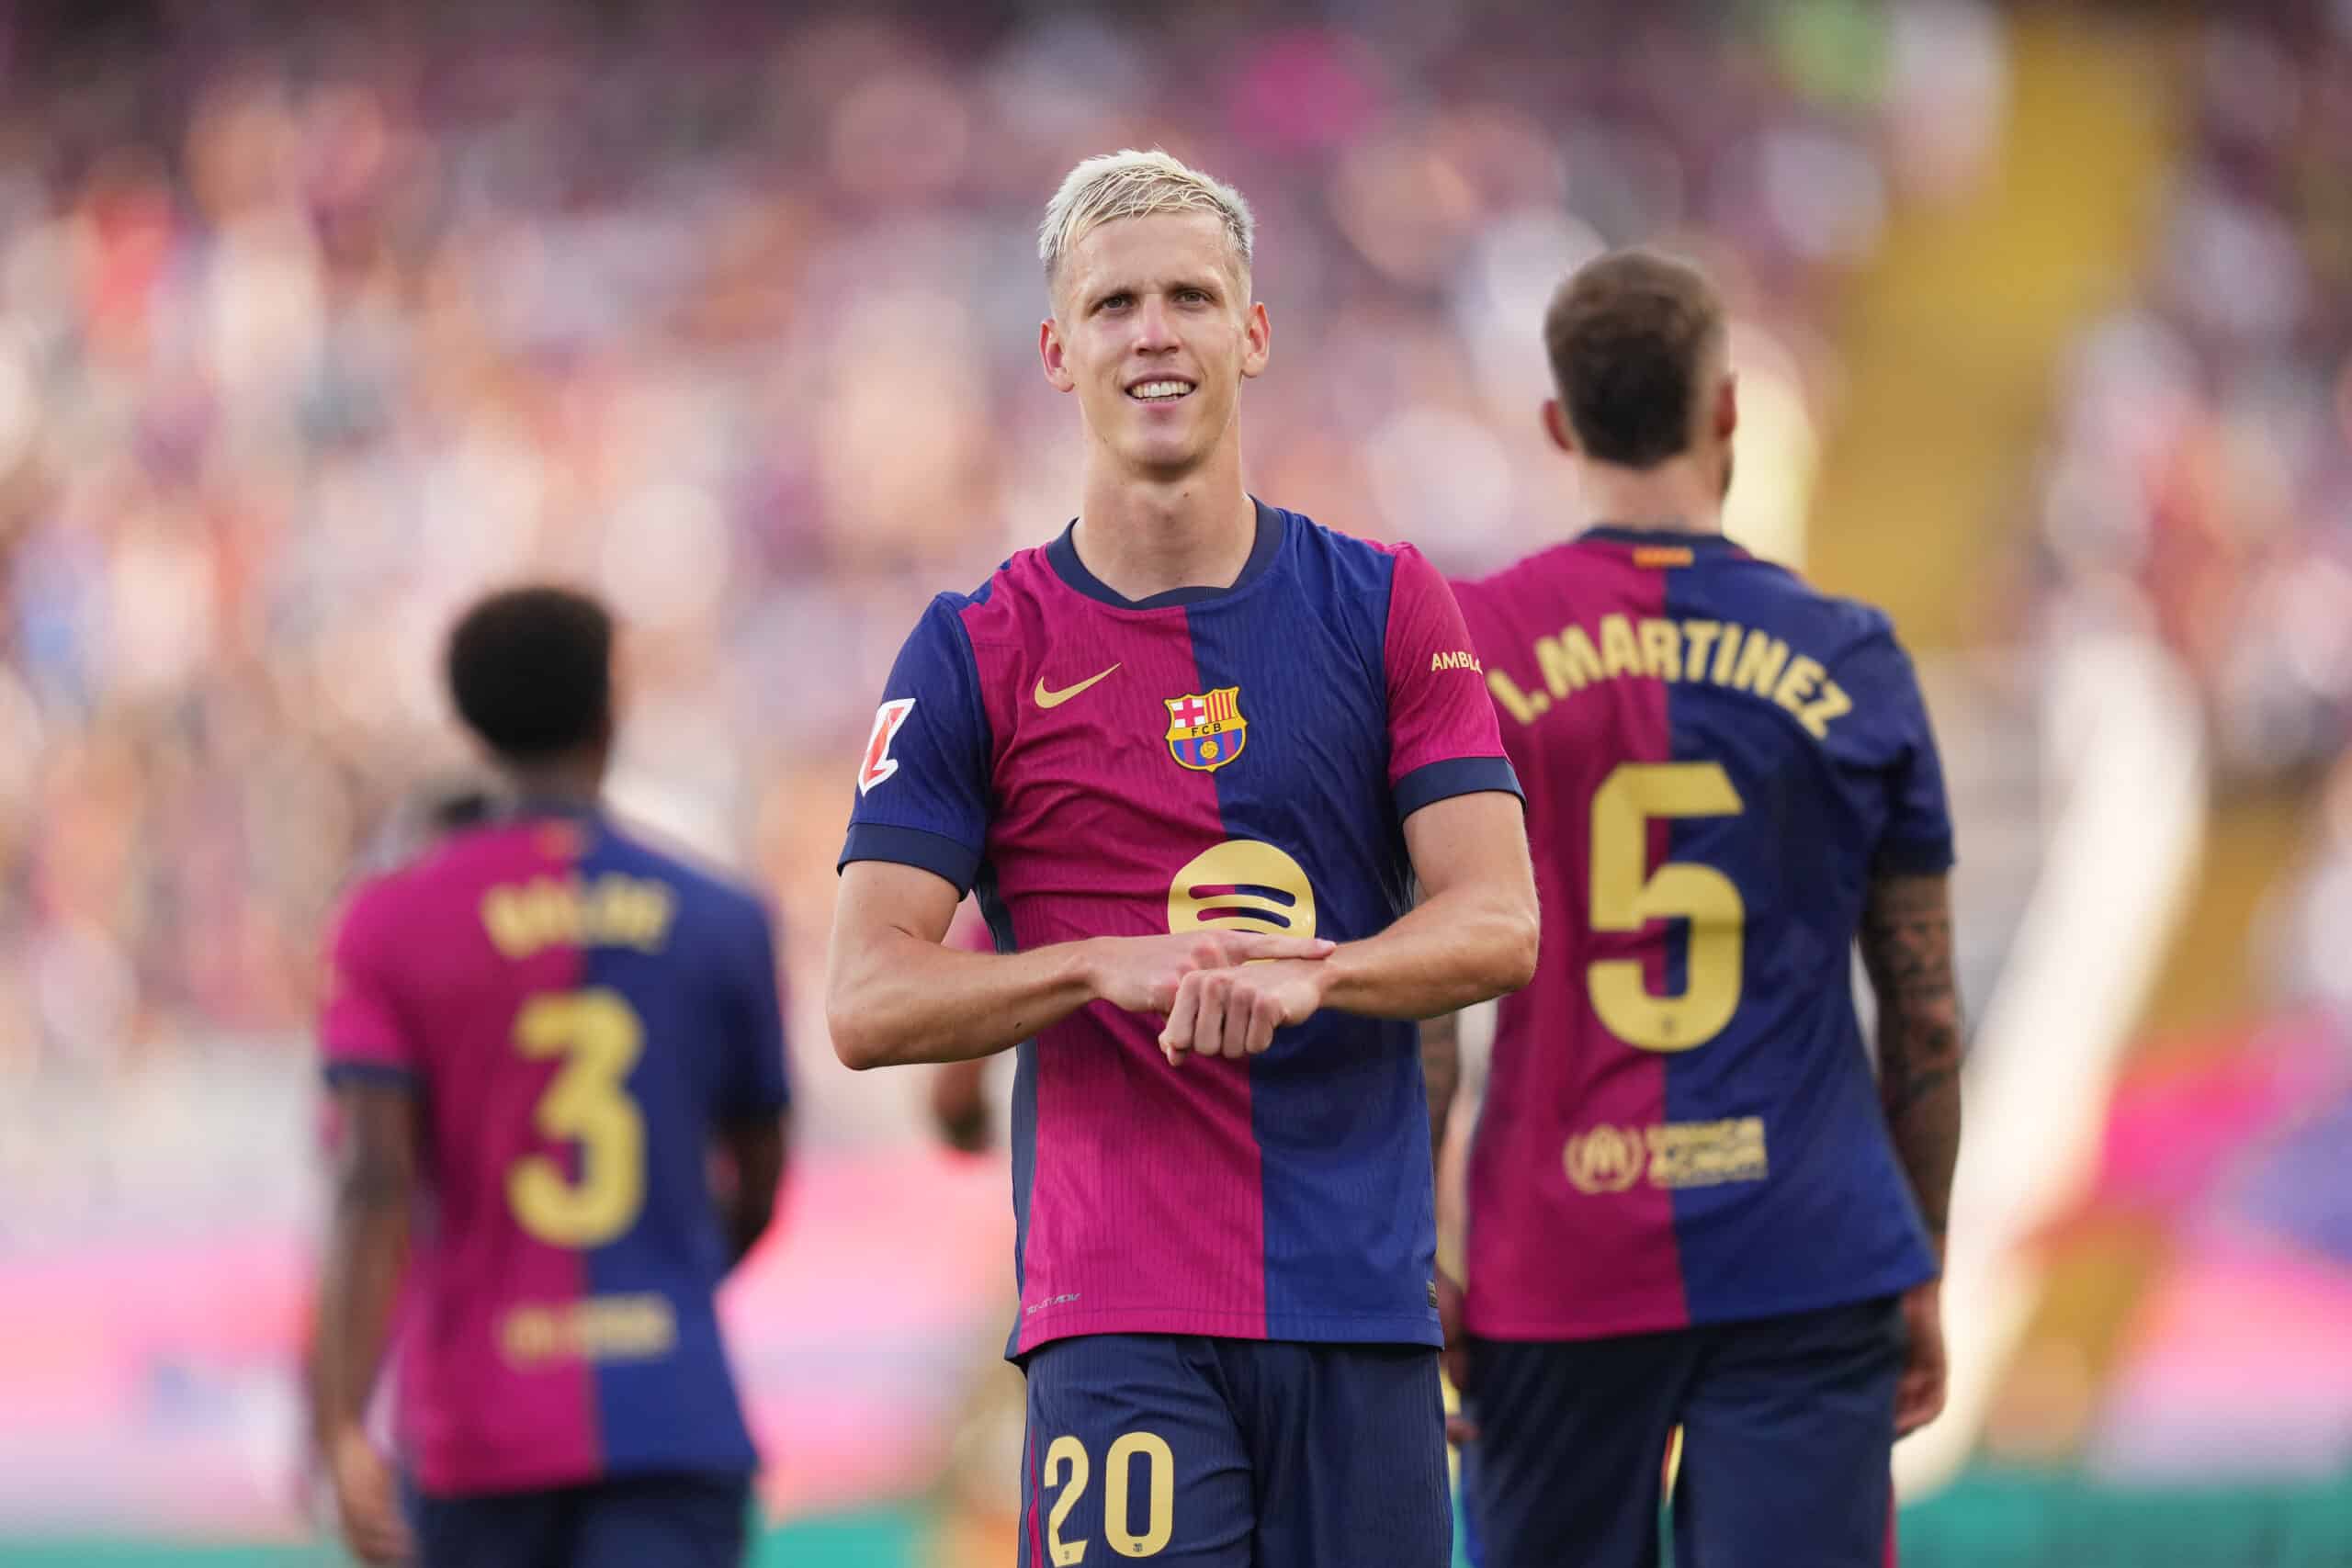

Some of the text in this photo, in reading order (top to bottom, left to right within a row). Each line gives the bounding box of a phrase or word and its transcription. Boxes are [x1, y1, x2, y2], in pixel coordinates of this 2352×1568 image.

[1587, 761, 1745, 1053] 5
[508, 988, 646, 1248] 3
[1044, 1431, 1174, 1567] 20
